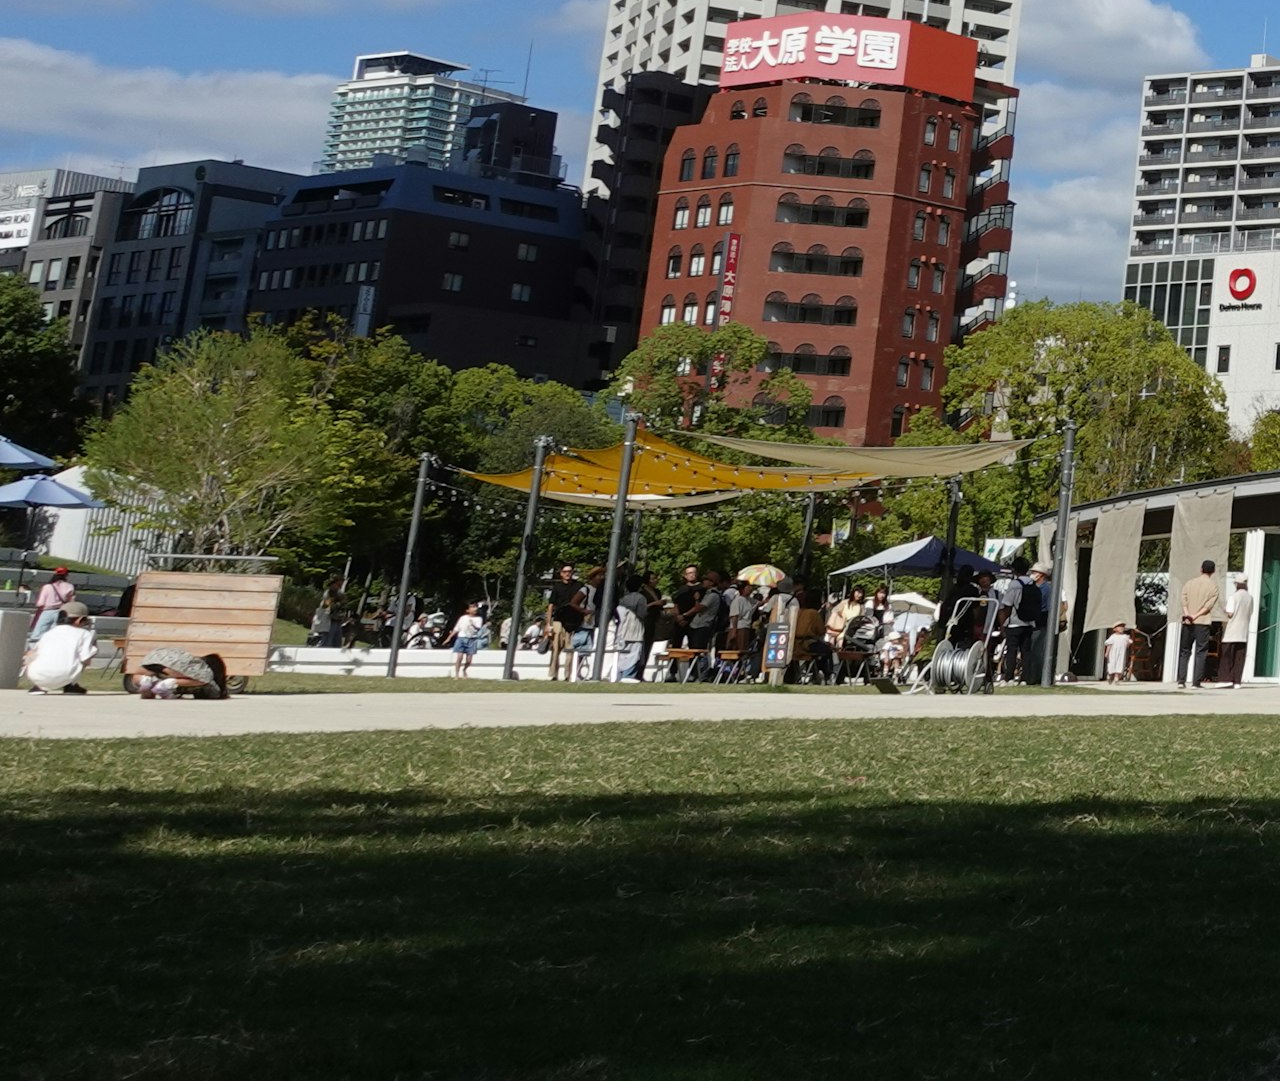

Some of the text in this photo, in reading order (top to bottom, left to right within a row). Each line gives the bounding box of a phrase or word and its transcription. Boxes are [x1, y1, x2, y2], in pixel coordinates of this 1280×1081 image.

[749, 25, 901, 70] 大原学園
[1219, 302, 1240, 312] Daiwa
